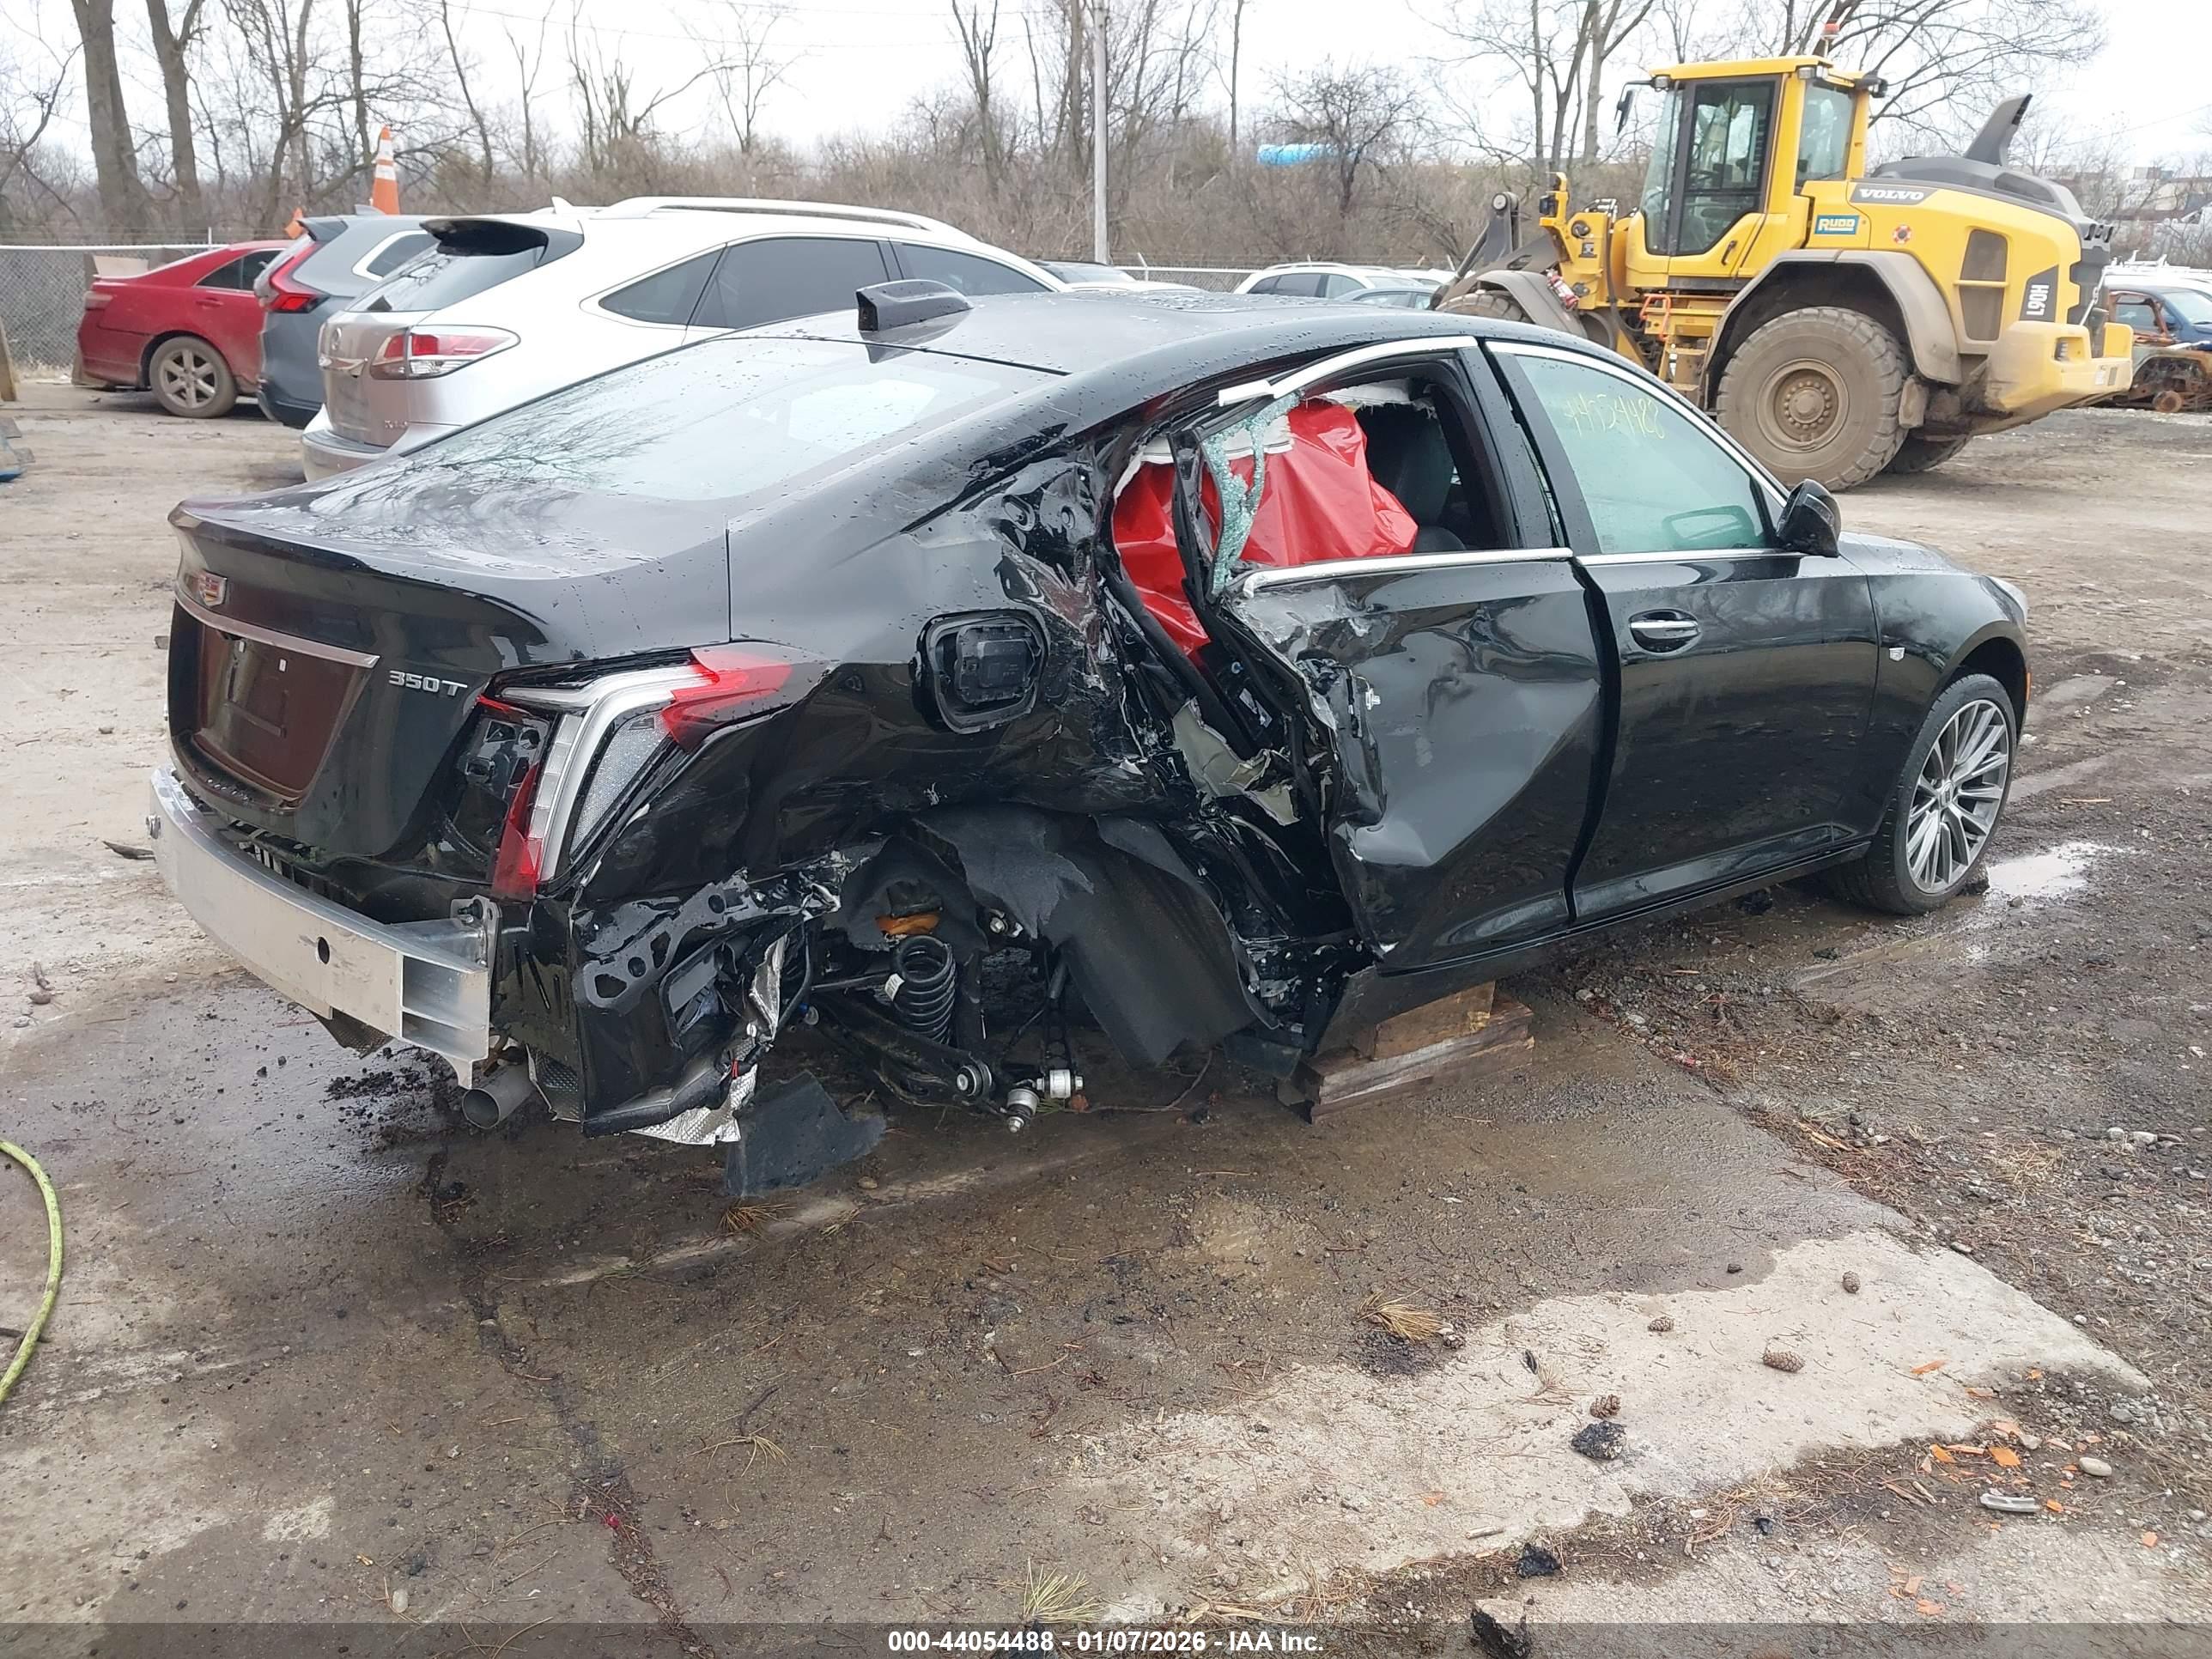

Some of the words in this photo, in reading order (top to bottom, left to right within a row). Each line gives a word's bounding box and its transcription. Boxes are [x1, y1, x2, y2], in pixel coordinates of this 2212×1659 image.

[1859, 188, 1924, 200] VOLVO
[1818, 218, 1856, 231] RUDD
[2026, 284, 2050, 316] L90H
[388, 670, 468, 696] 350T
